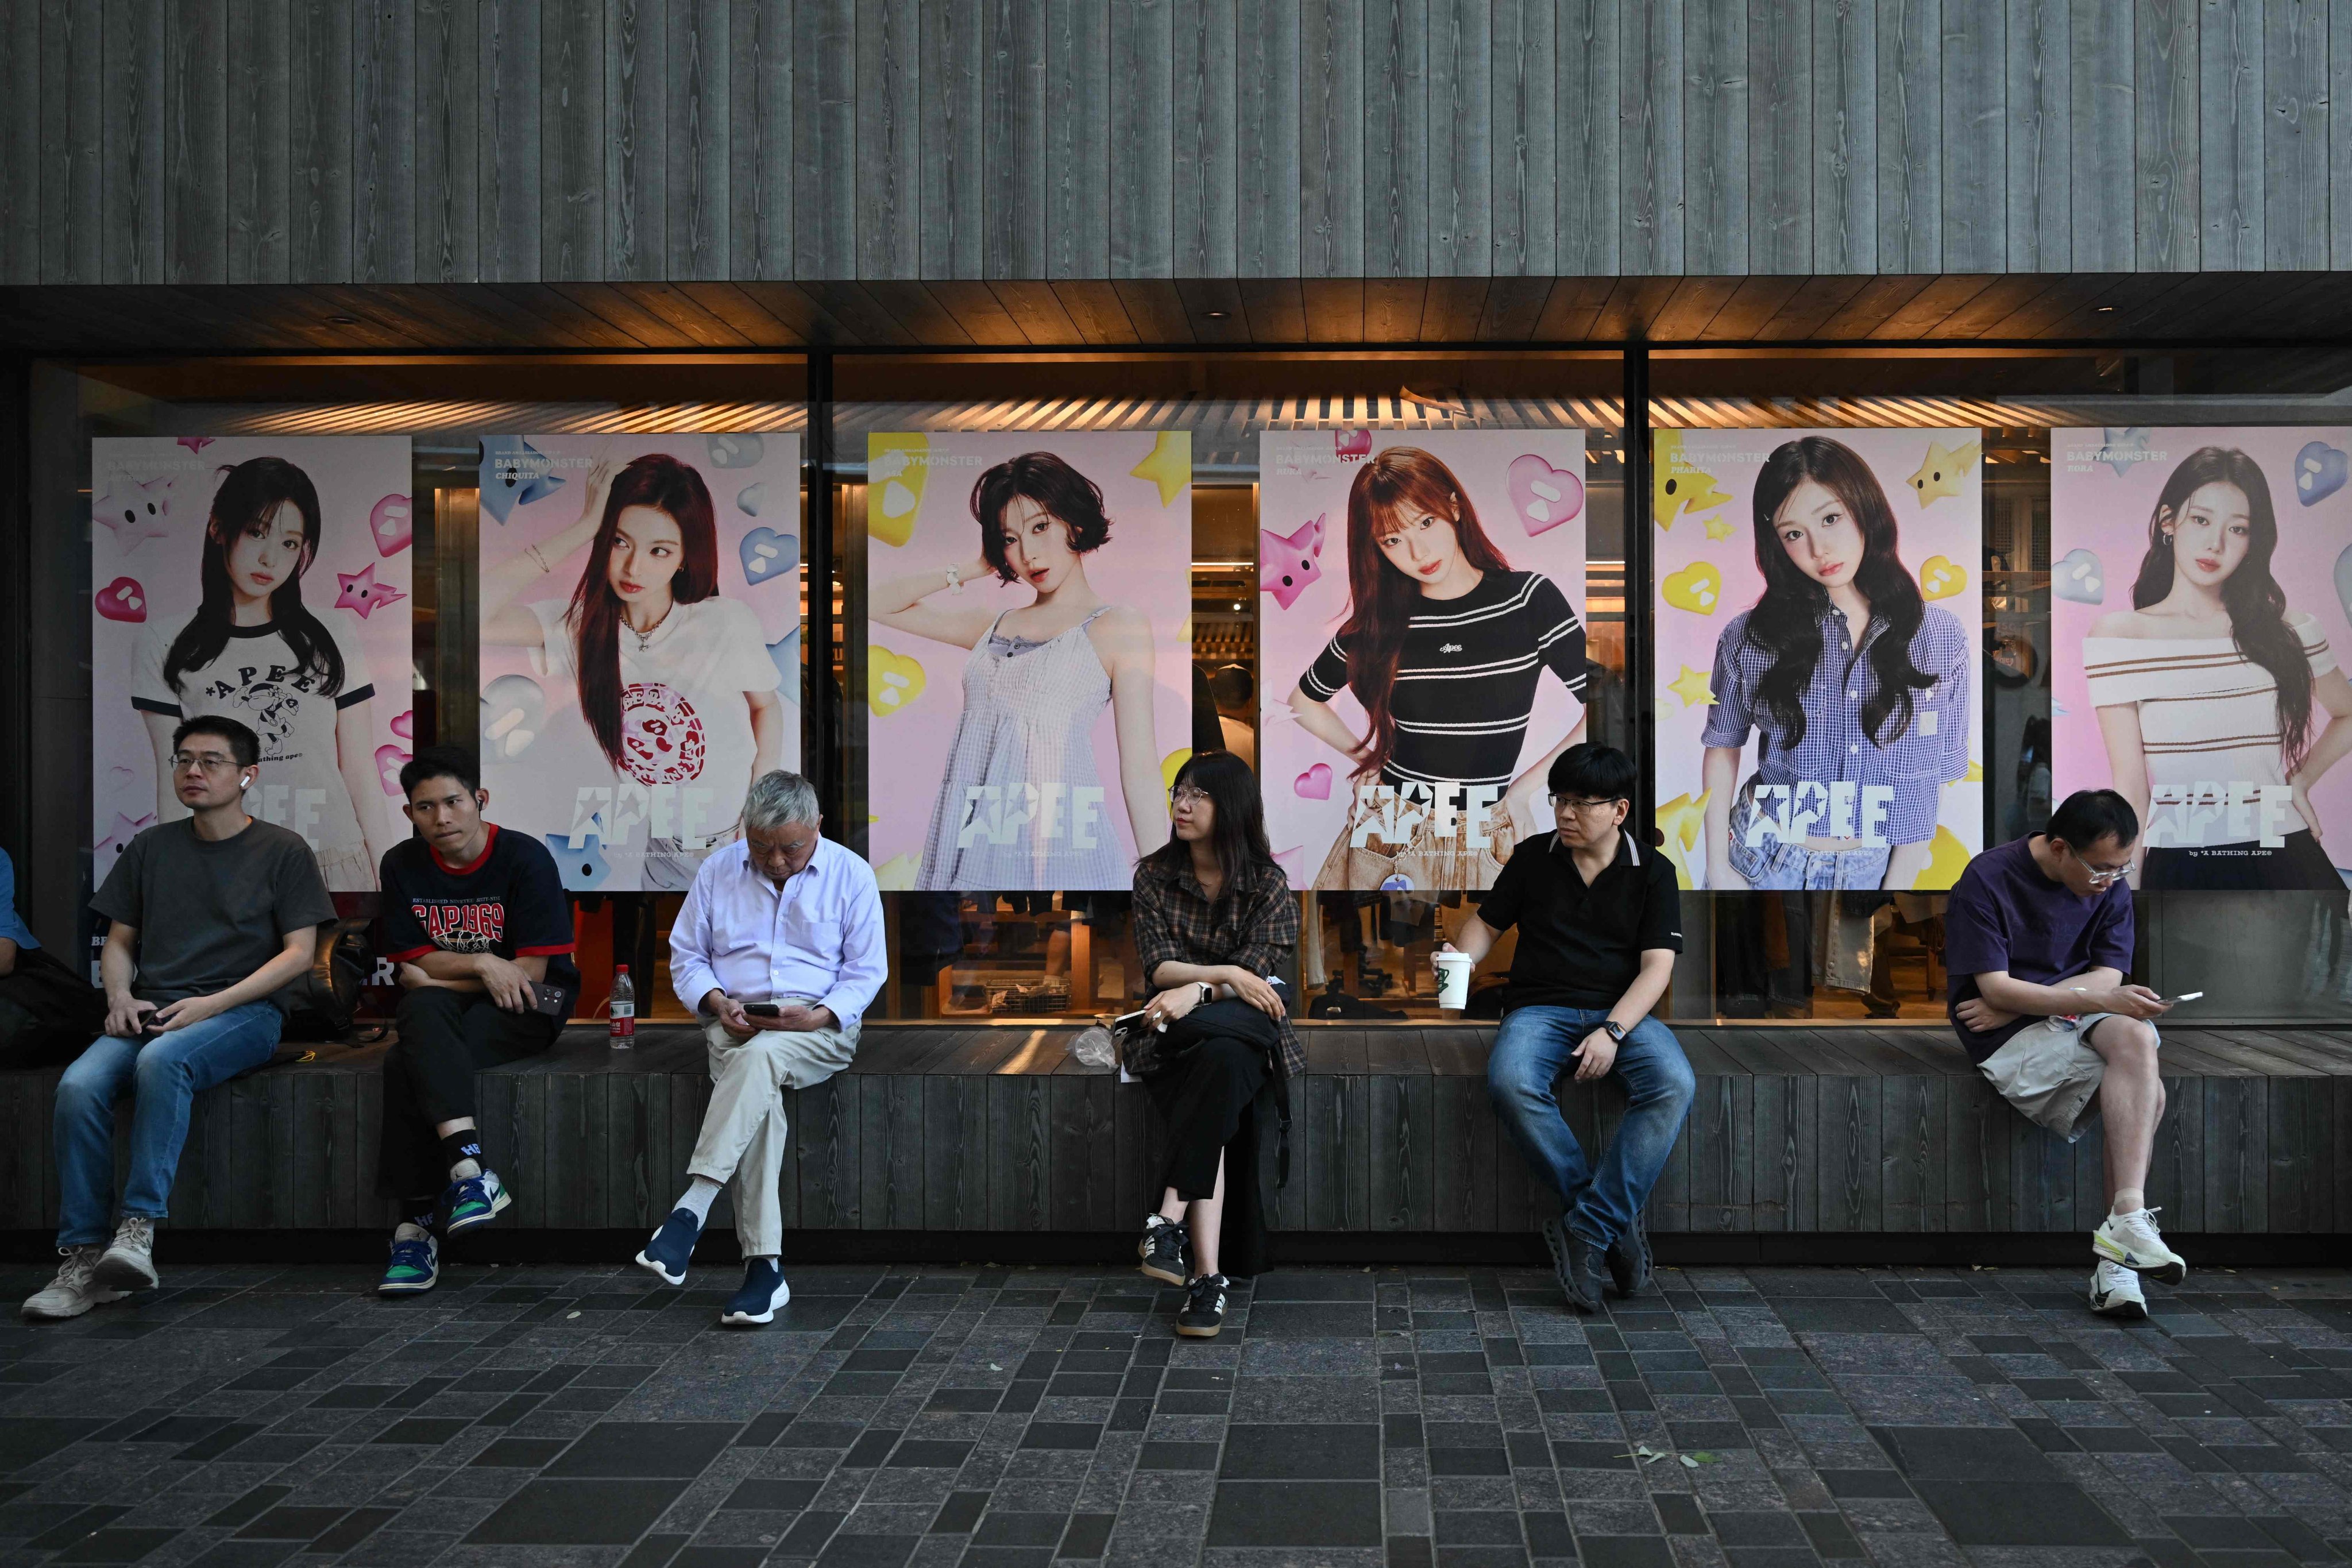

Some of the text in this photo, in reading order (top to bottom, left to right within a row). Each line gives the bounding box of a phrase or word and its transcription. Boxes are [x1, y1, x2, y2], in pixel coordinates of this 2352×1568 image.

[884, 456, 983, 466] BABYMONSTER
[1276, 454, 1375, 464] BABYMONSTER
[1670, 453, 1770, 462] BABYMONSTER
[2067, 451, 2168, 461] BABYMONSTER
[495, 458, 593, 469] BABYMONSTER
[496, 472, 540, 480] CHIQUITA
[257, 754, 284, 763] athing
[567, 783, 714, 850] APEE
[957, 782, 1104, 849] APEE
[1350, 782, 1498, 848] APEE
[1745, 781, 1894, 848] APEE
[2142, 781, 2292, 848] APEE
[411, 903, 504, 942] GAP 1969
